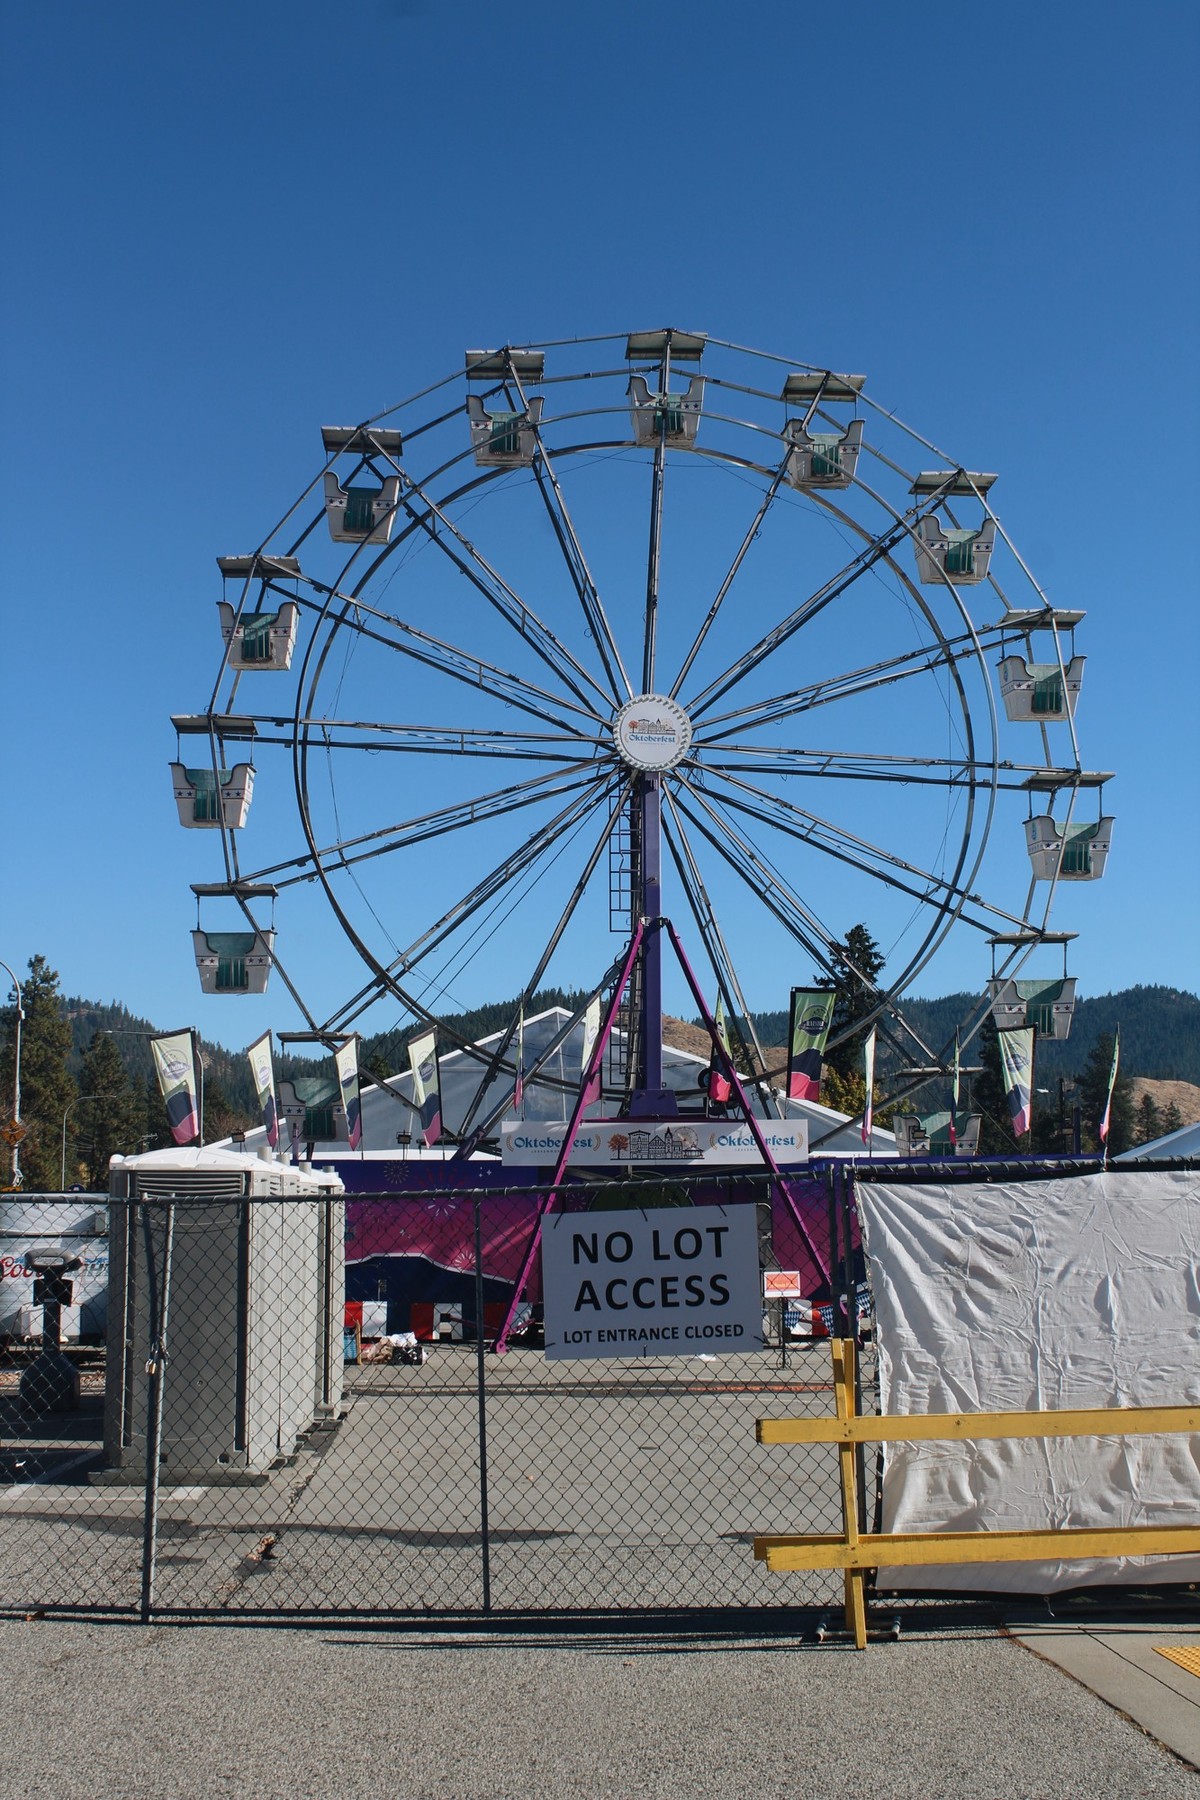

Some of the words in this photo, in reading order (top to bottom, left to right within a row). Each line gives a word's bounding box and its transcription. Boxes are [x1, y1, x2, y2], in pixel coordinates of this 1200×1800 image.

[628, 734, 676, 743] Oktoberfest
[513, 1136, 593, 1148] Oktobeest
[717, 1134, 796, 1147] Oktobrfest
[572, 1231, 634, 1265] NO
[652, 1226, 730, 1262] LOT
[573, 1273, 731, 1312] ACCESS
[563, 1329, 594, 1345] LOT
[597, 1326, 680, 1343] ENTRANCE
[684, 1323, 745, 1340] CLOSED
